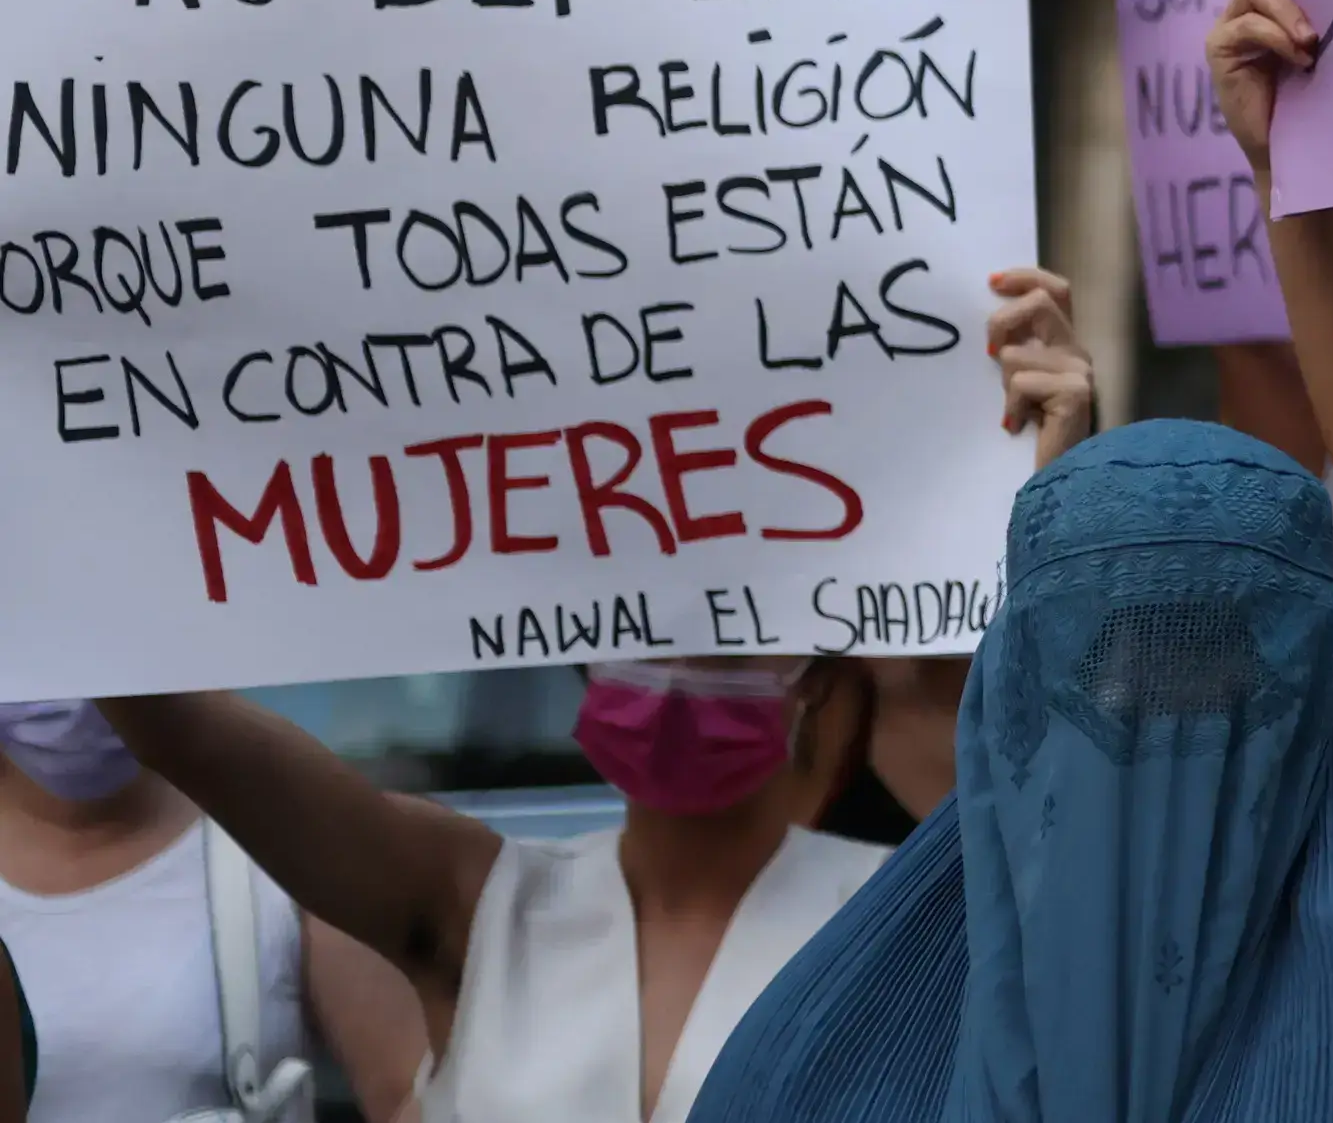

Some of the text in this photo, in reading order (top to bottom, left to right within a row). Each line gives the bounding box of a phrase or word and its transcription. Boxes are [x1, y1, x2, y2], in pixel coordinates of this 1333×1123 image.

[6, 54, 498, 177] NINGUNA
[0, 132, 957, 328] ORQUE TODAS ESTÁN
[54, 259, 962, 444] EN CONTRA DE LAS
[186, 398, 866, 603] MUJERES
[469, 575, 1003, 661] NAWAL EL SAADAW
